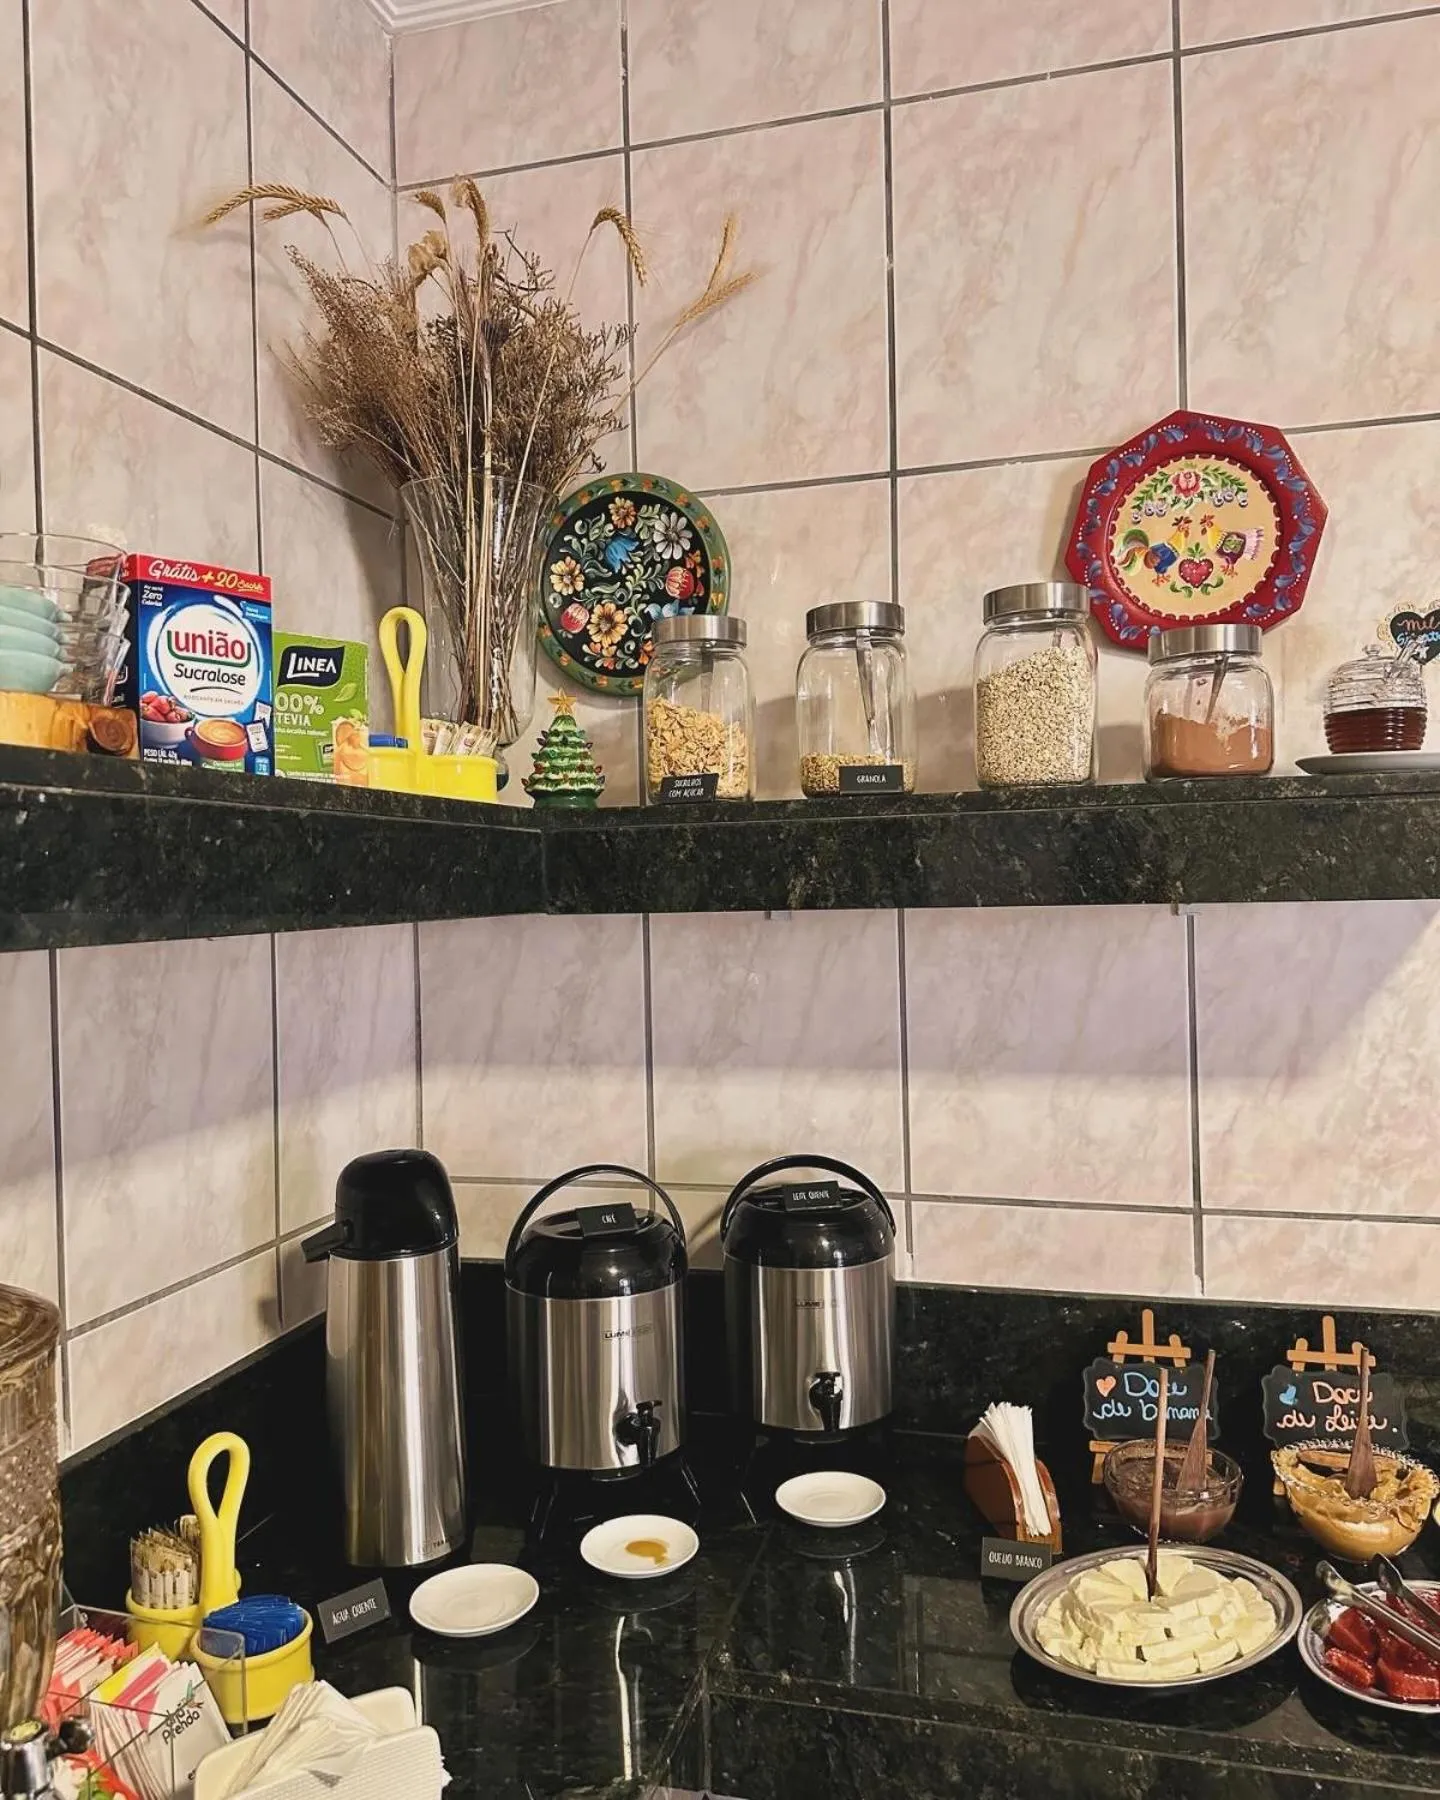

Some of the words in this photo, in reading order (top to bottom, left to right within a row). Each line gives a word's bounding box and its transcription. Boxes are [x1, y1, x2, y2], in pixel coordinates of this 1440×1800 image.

[148, 559, 201, 582] Grátis
[214, 571, 238, 589] 20
[143, 589, 163, 600] Zero
[174, 629, 245, 660] união
[174, 663, 246, 686] Sucralose
[286, 653, 337, 678] LINEA
[274, 692, 325, 715] 00%
[275, 711, 312, 727] TEVIA
[856, 774, 887, 784] GRANOLA
[1123, 1371, 1188, 1397] Doe
[1093, 1399, 1132, 1419] de
[1139, 1399, 1213, 1420] bnan
[1276, 1409, 1316, 1428] de
[1015, 1554, 1043, 1569] BRANCO
[351, 1598, 377, 1618] QUENTE
